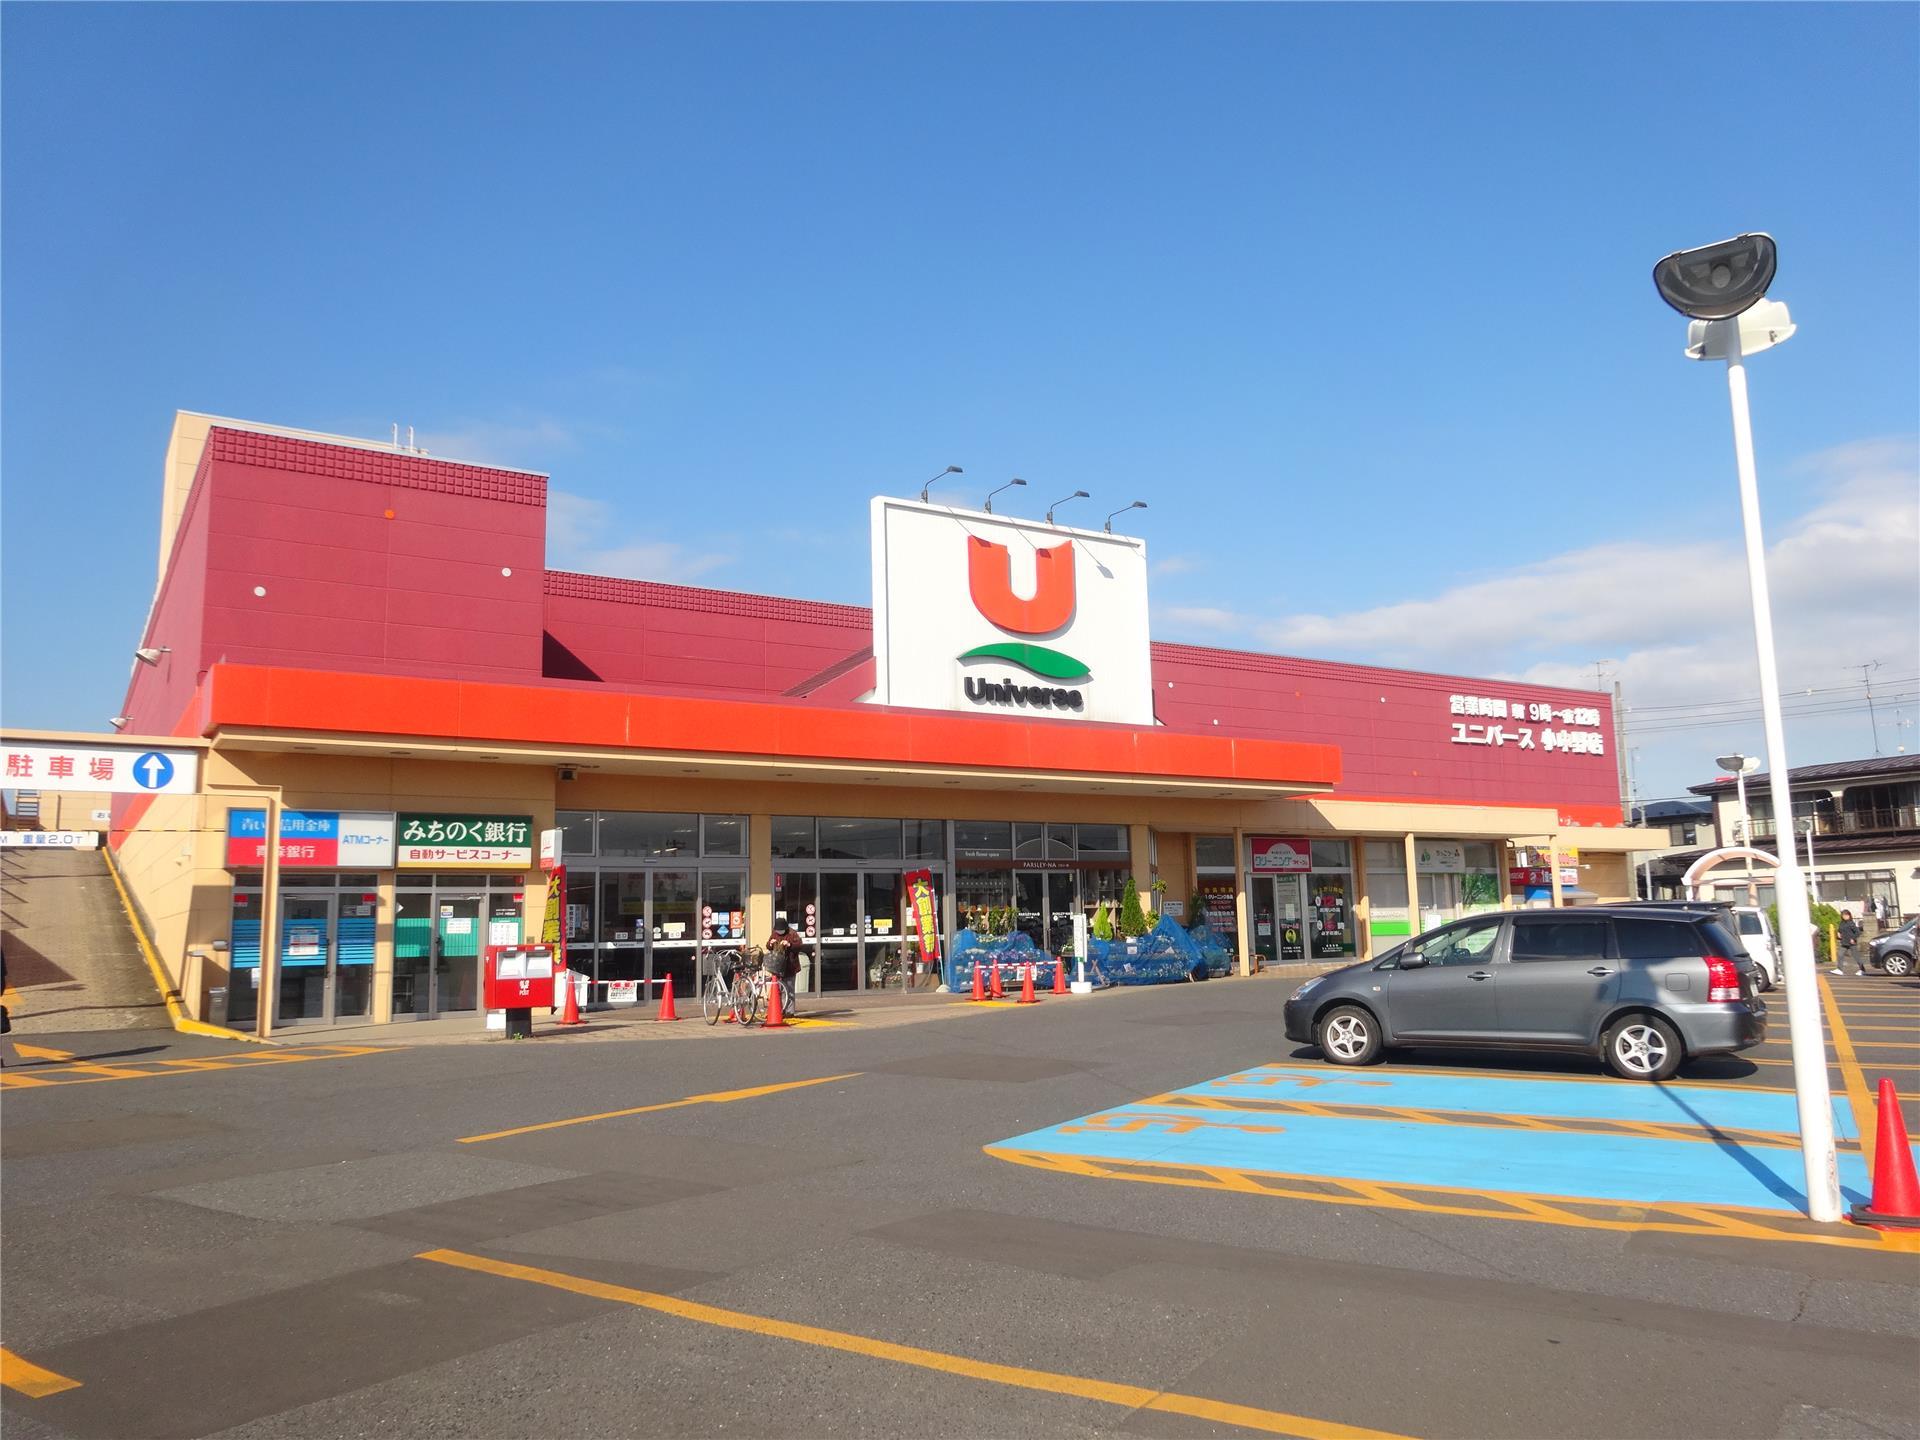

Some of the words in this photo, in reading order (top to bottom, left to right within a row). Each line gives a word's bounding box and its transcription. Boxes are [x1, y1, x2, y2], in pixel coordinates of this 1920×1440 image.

[964, 677, 1083, 710] Universe
[1449, 695, 1507, 719] 営業時間
[6, 754, 115, 781] 駐車場
[241, 818, 331, 833] 青い信用金庫
[403, 820, 528, 844] みちのく銀行
[342, 834, 389, 846] ATMコーナー
[409, 848, 521, 860] 自動サービスコーナー
